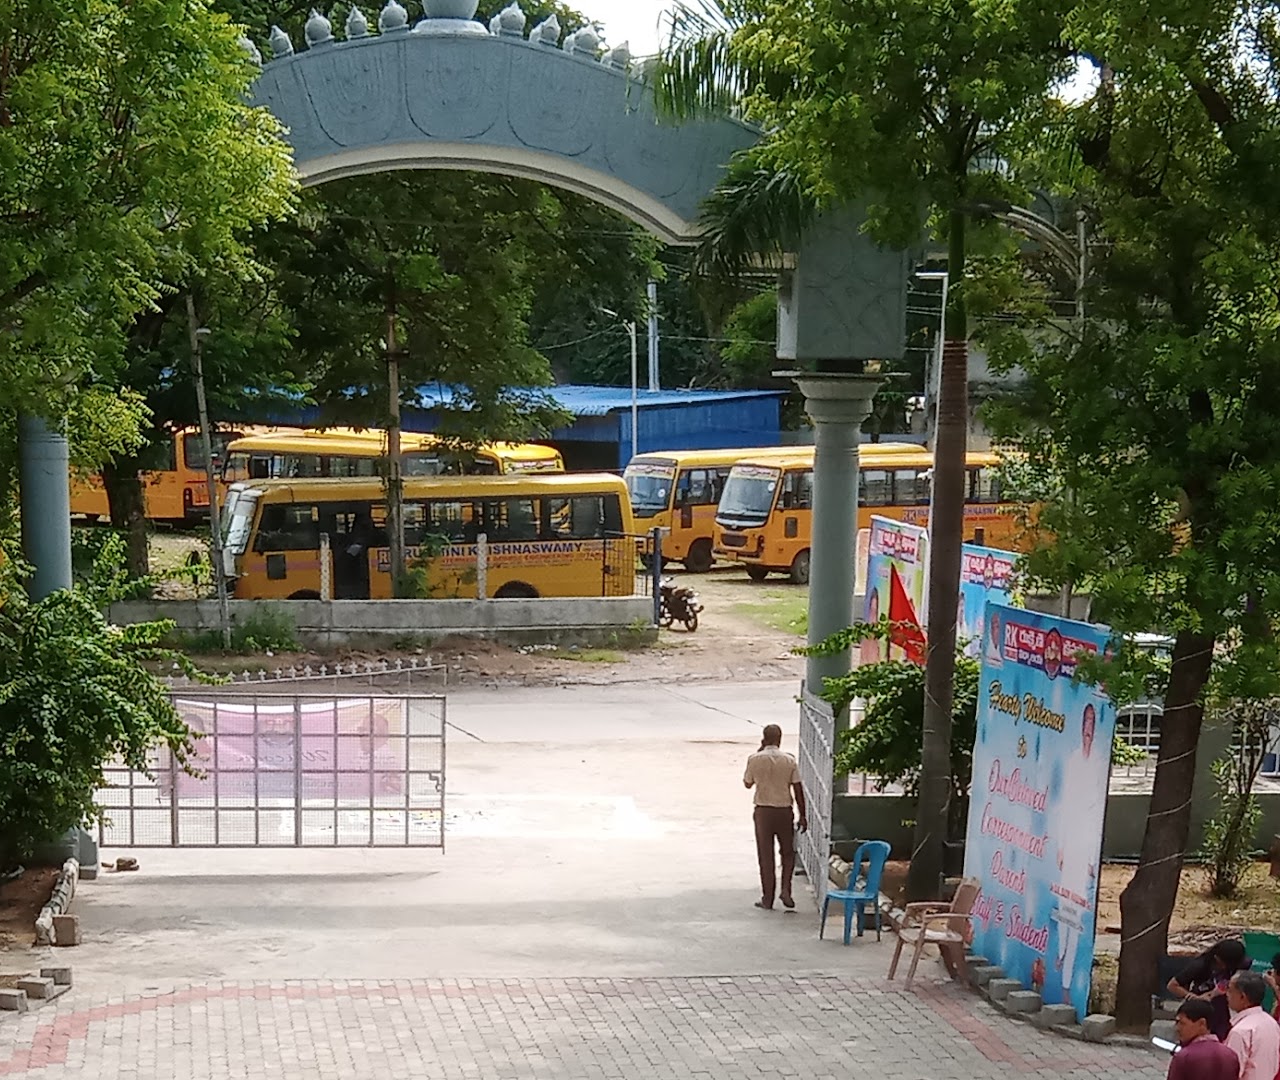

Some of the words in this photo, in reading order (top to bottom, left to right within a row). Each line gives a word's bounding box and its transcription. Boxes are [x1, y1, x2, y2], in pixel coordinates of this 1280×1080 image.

[404, 545, 466, 558] RUINI
[468, 542, 583, 556] KISHNASWAMY
[1004, 623, 1019, 649] RK
[1023, 692, 1066, 734] Welcome
